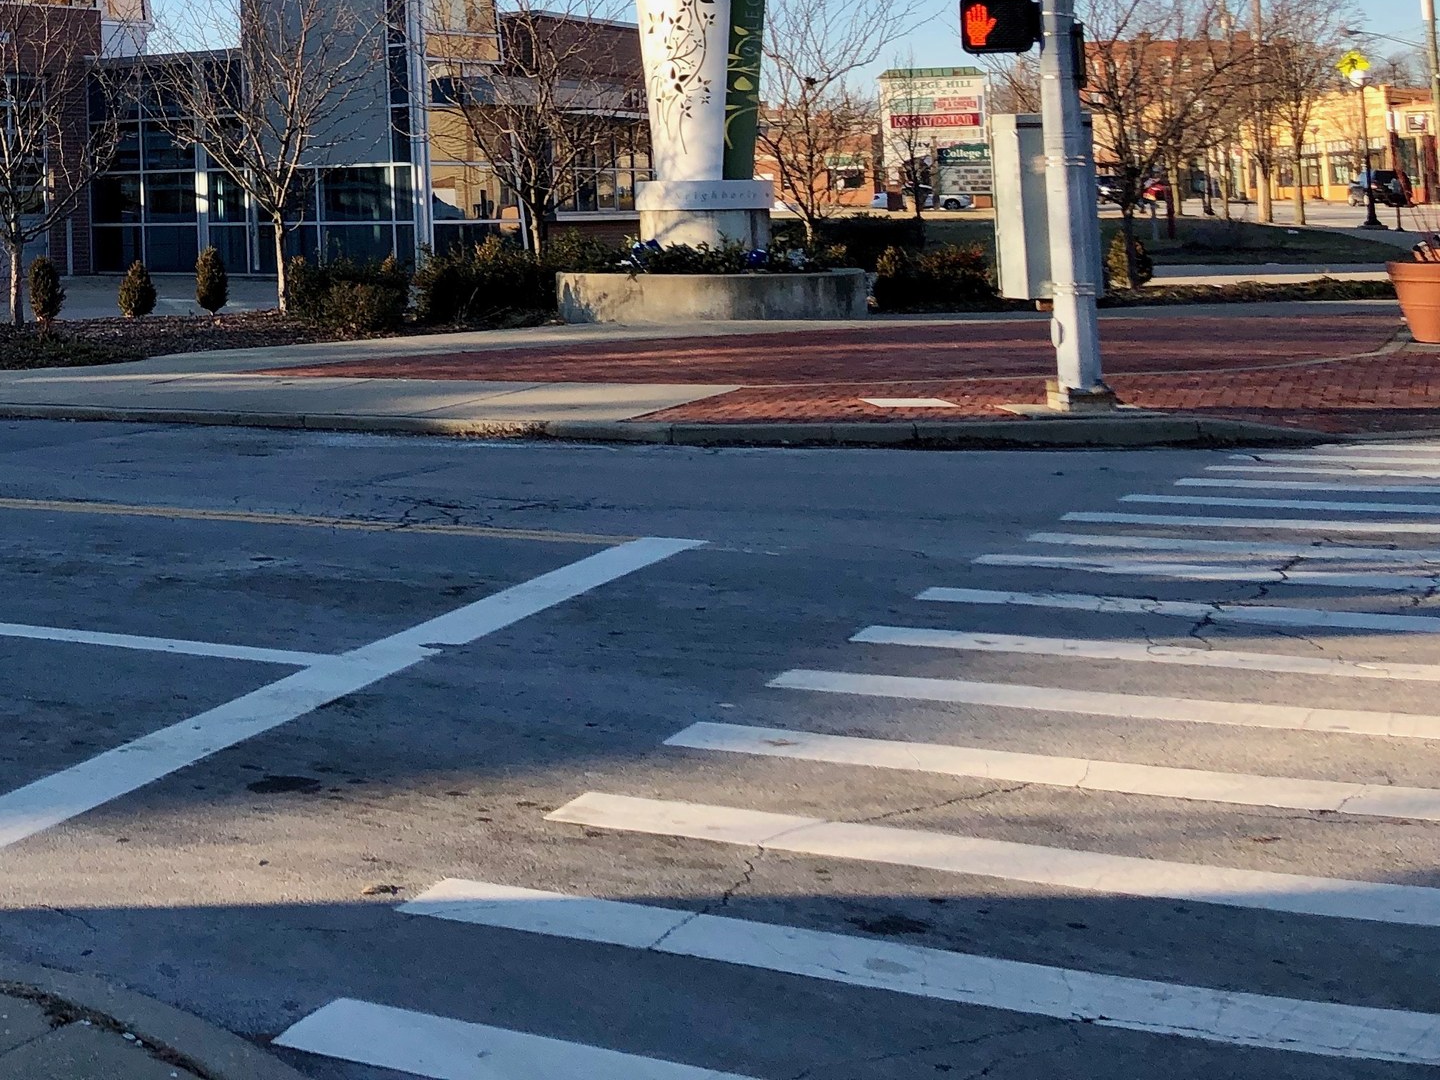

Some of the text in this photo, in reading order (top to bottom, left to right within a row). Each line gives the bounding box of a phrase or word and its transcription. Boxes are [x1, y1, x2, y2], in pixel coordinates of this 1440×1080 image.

[890, 80, 973, 90] COLEGE HILL
[933, 114, 973, 126] DOLLAR
[942, 149, 981, 159] College
